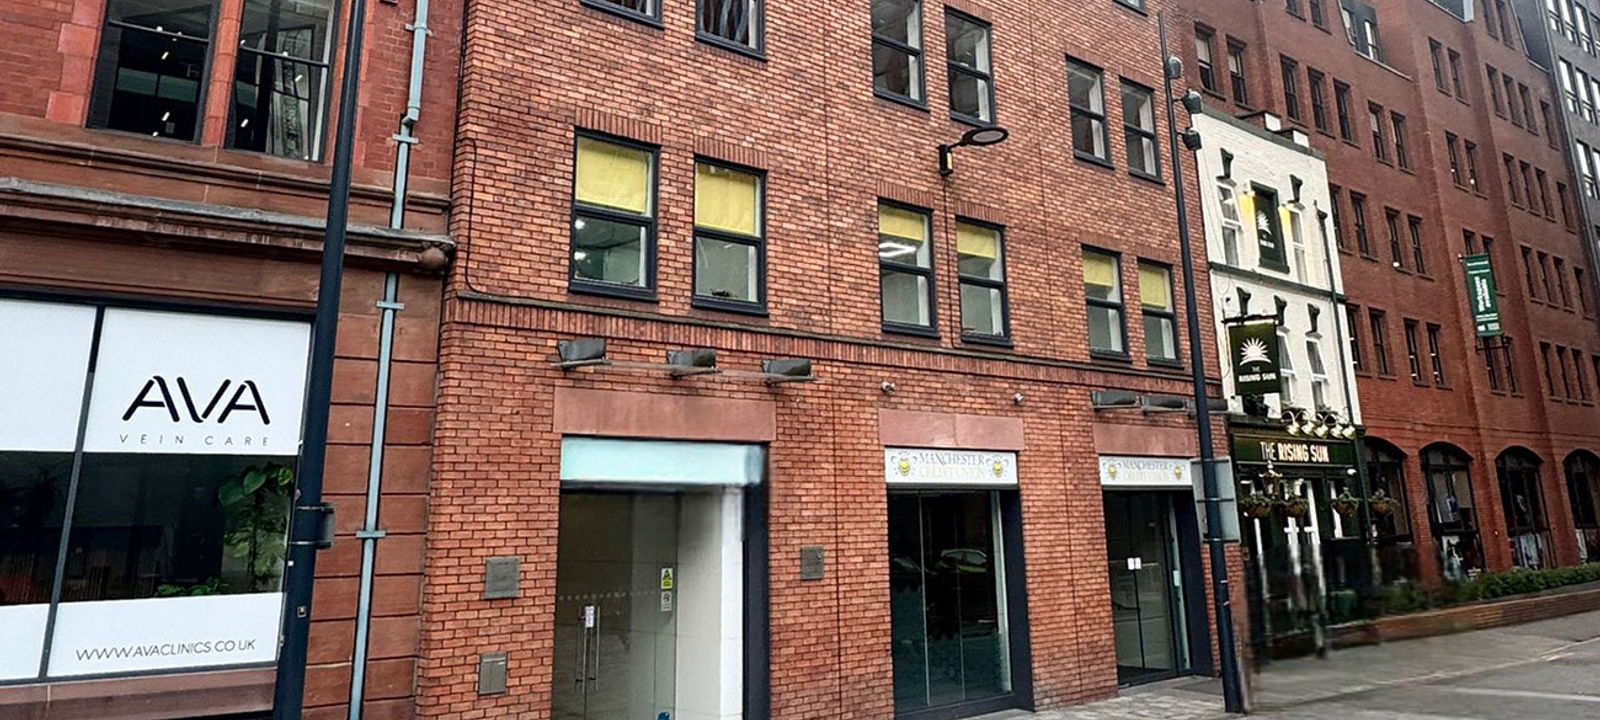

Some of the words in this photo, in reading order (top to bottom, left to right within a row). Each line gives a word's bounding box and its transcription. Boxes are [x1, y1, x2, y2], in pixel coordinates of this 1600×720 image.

[1238, 373, 1261, 382] RISING
[1262, 372, 1276, 381] SUN
[122, 375, 270, 425] AVA
[119, 434, 184, 444] VEIN
[204, 435, 268, 446] CARE
[919, 452, 985, 466] MANCHESTER
[1260, 441, 1277, 461] THE
[1277, 442, 1309, 462] RISING
[1310, 445, 1329, 463] SUN
